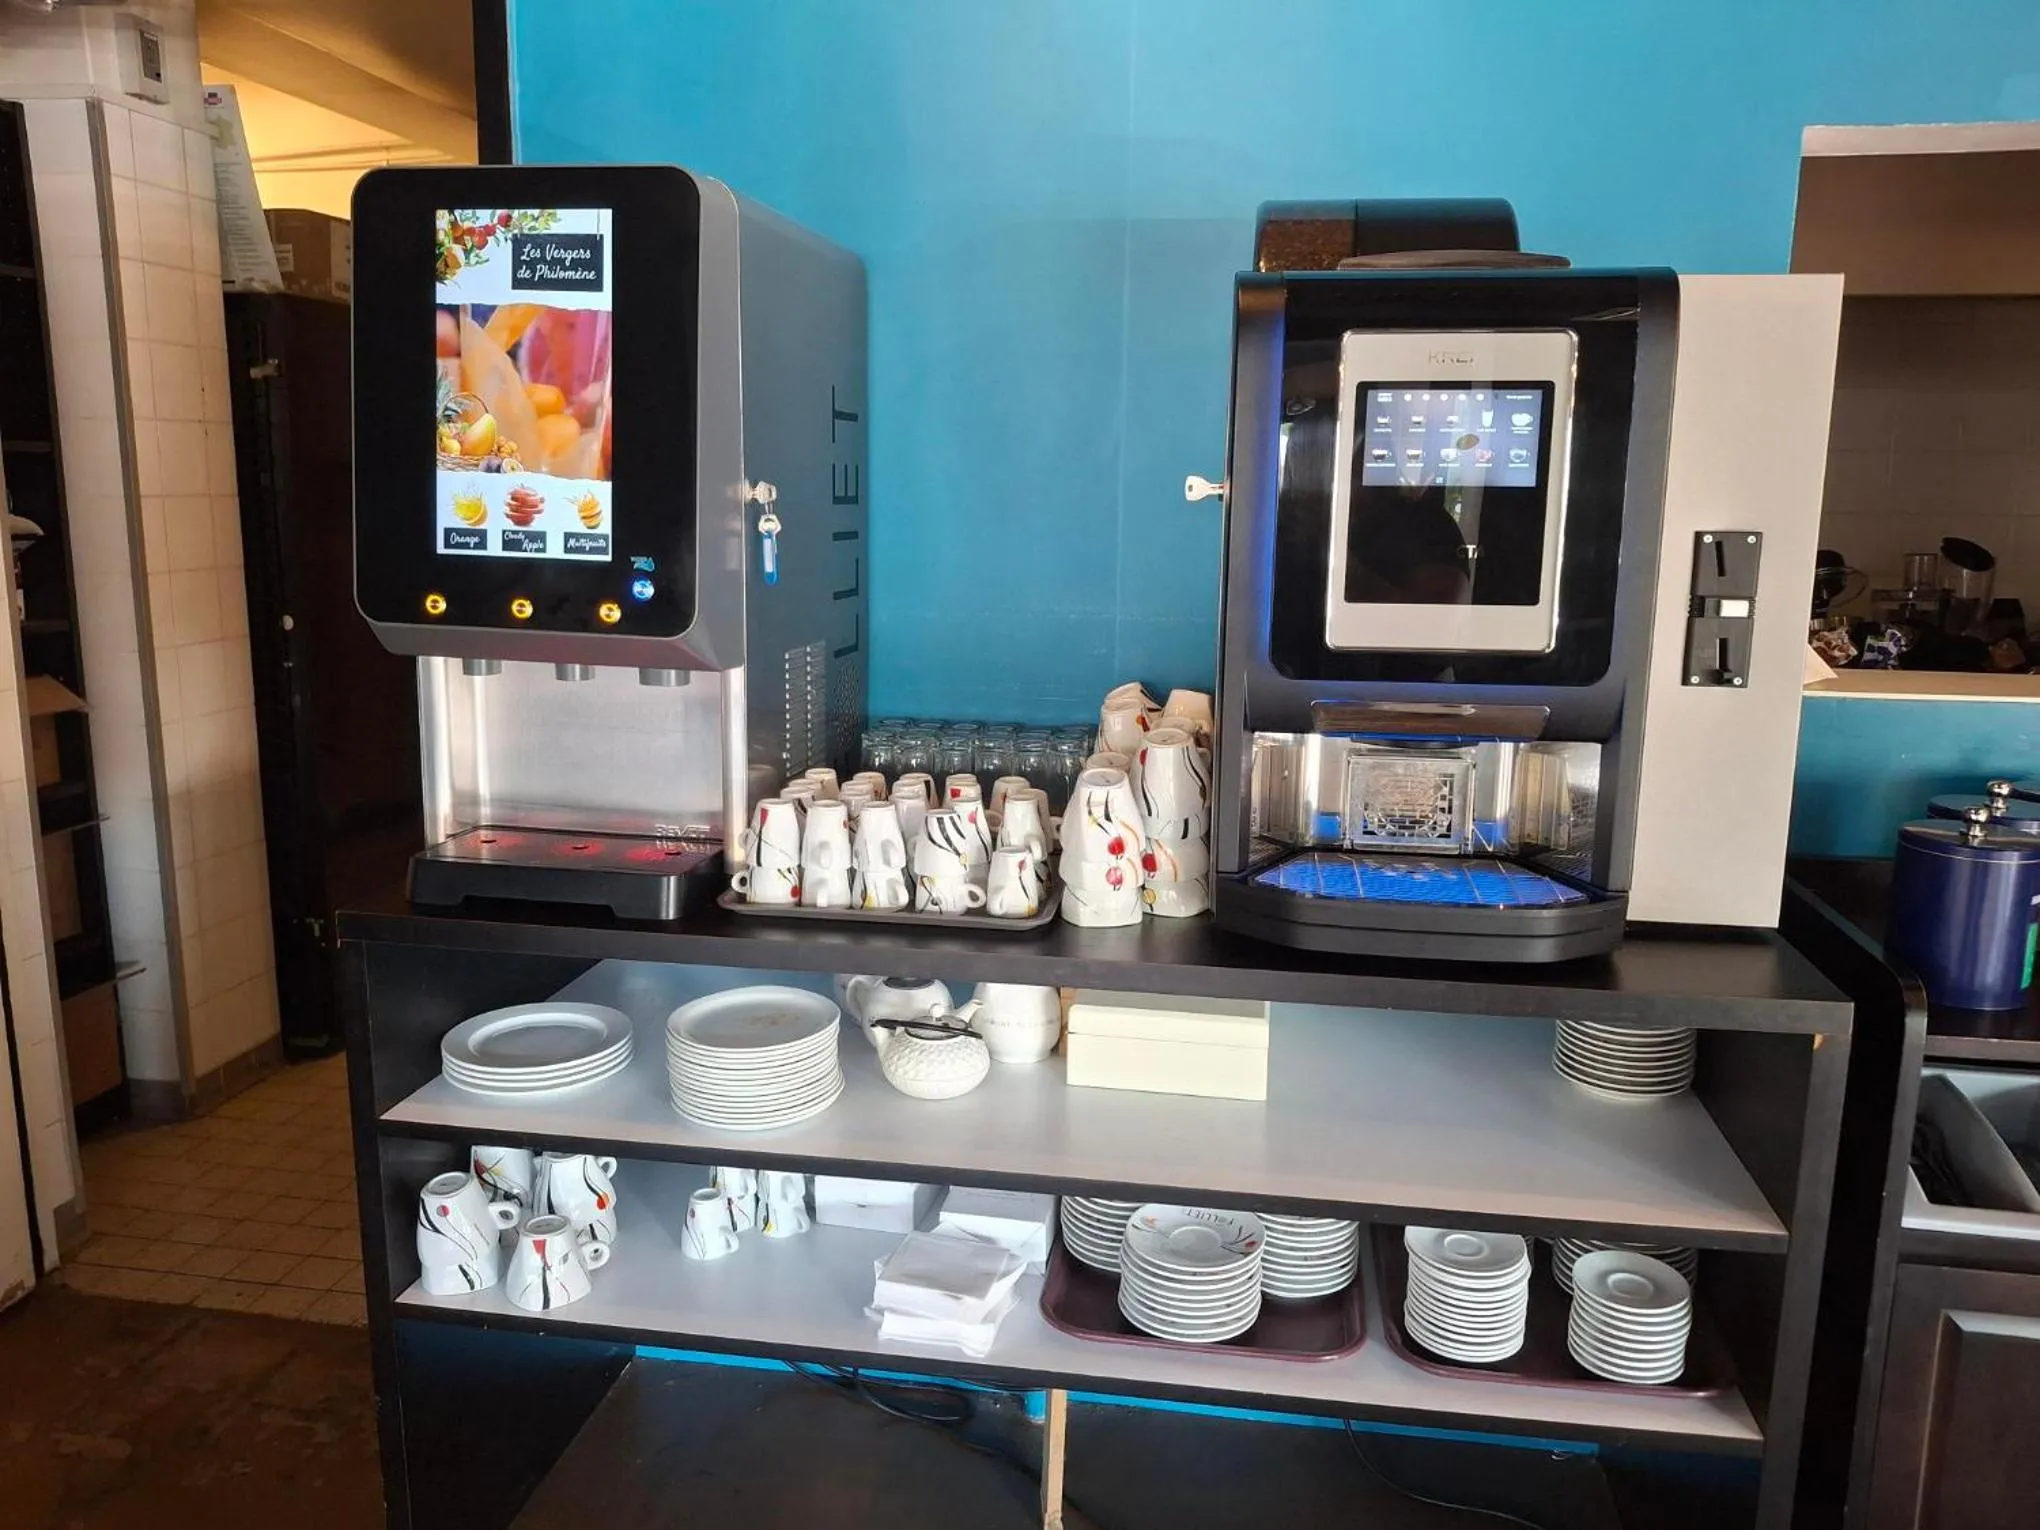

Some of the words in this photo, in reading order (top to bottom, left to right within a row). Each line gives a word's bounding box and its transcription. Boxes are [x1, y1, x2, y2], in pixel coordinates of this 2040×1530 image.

[520, 243, 541, 261] Les
[546, 243, 591, 266] Vergers
[516, 264, 533, 279] de
[534, 264, 597, 282] Philomène
[450, 532, 481, 548] Orange
